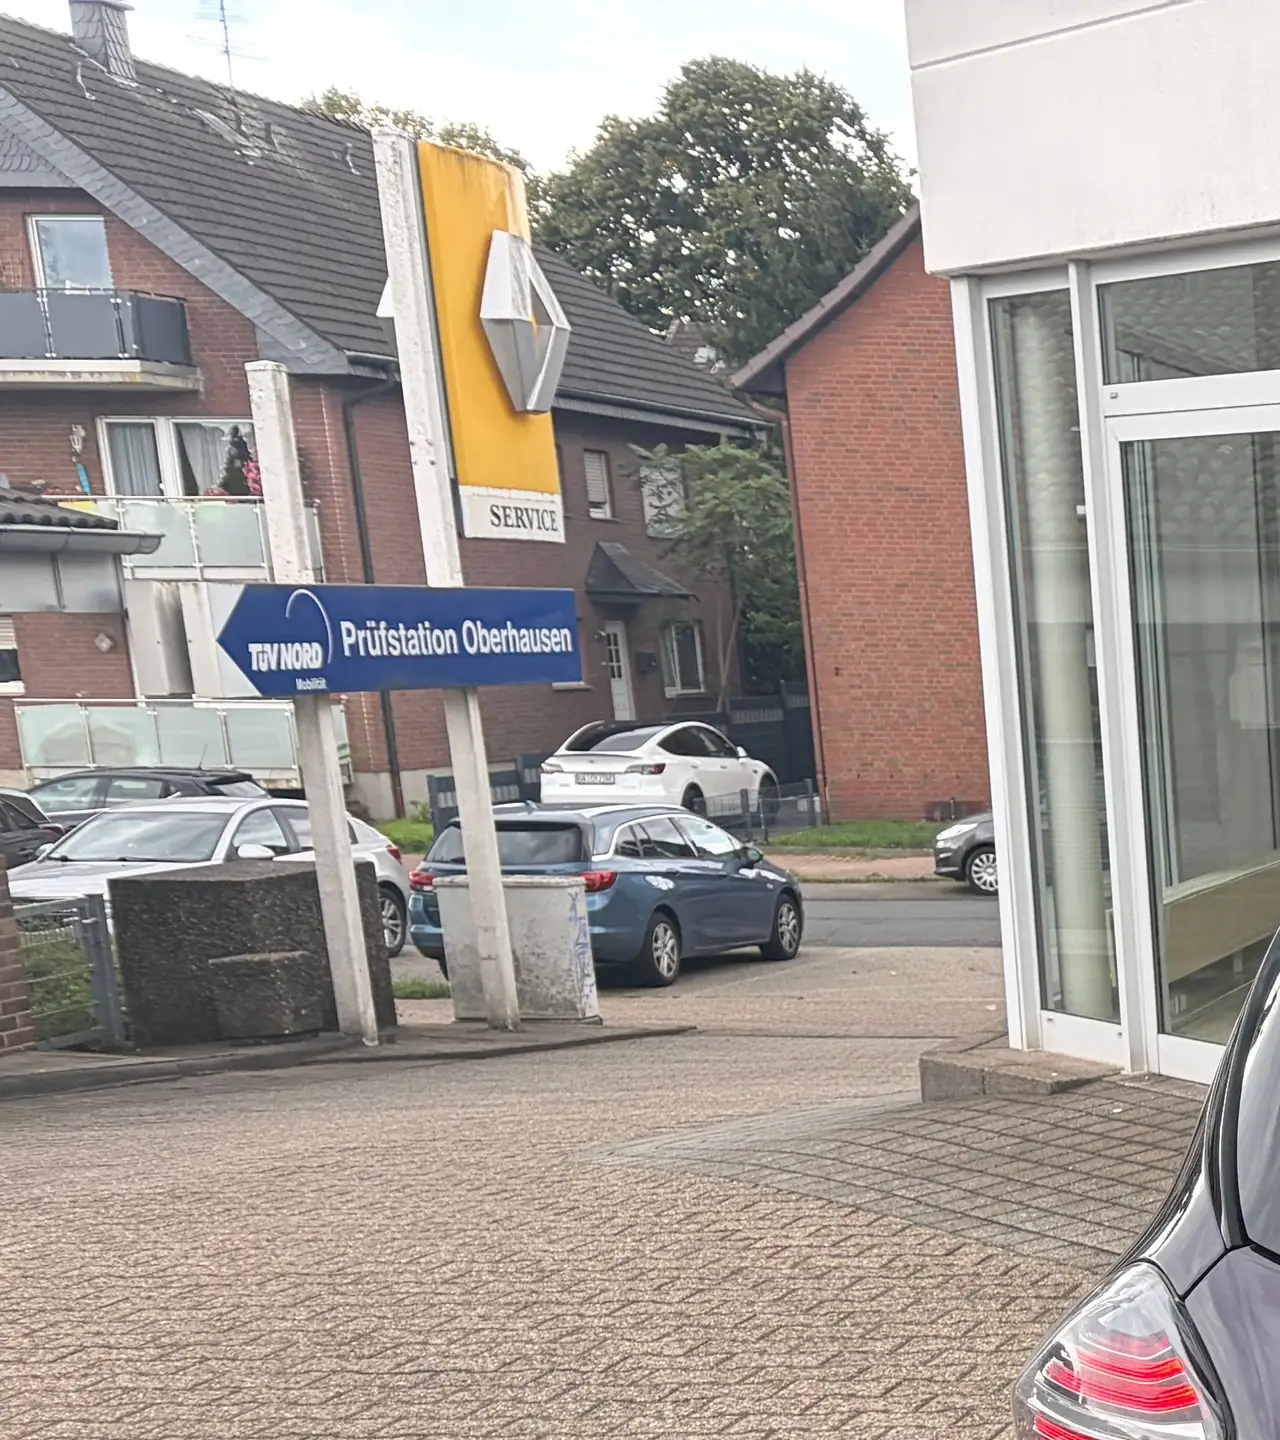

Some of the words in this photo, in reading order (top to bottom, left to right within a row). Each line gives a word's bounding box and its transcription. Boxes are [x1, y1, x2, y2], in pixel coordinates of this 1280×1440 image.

[489, 503, 558, 532] SERVICE
[339, 619, 458, 657] Prüfstation
[461, 619, 574, 656] Oberhausen
[280, 642, 323, 671] NORD
[295, 676, 328, 691] Mobilität
